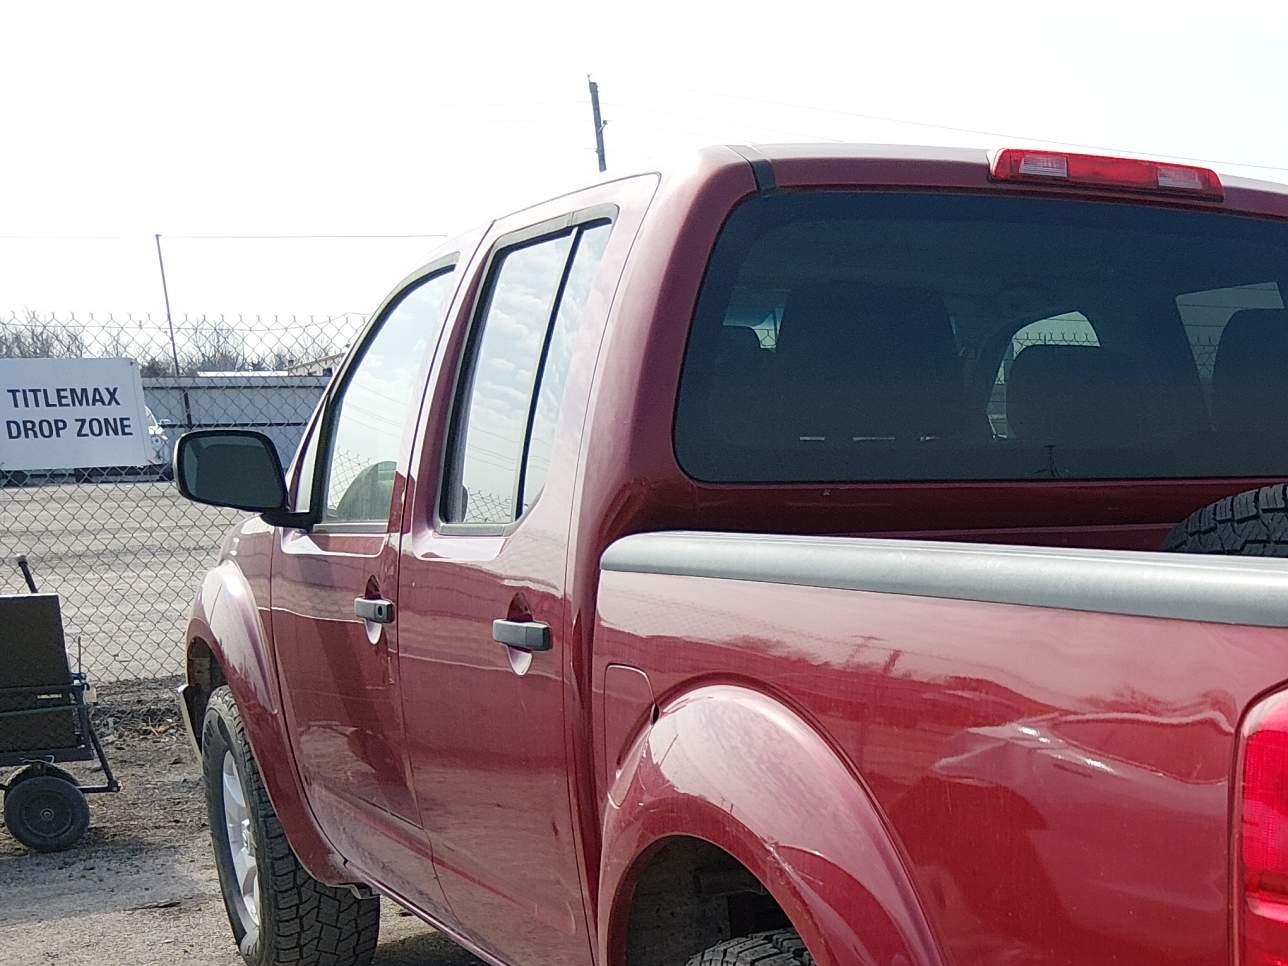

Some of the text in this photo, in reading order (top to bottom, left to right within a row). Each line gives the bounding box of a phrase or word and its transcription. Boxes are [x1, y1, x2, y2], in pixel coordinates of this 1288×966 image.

[7, 387, 121, 408] TITLEMAX
[6, 417, 133, 439] DROP ZONE
